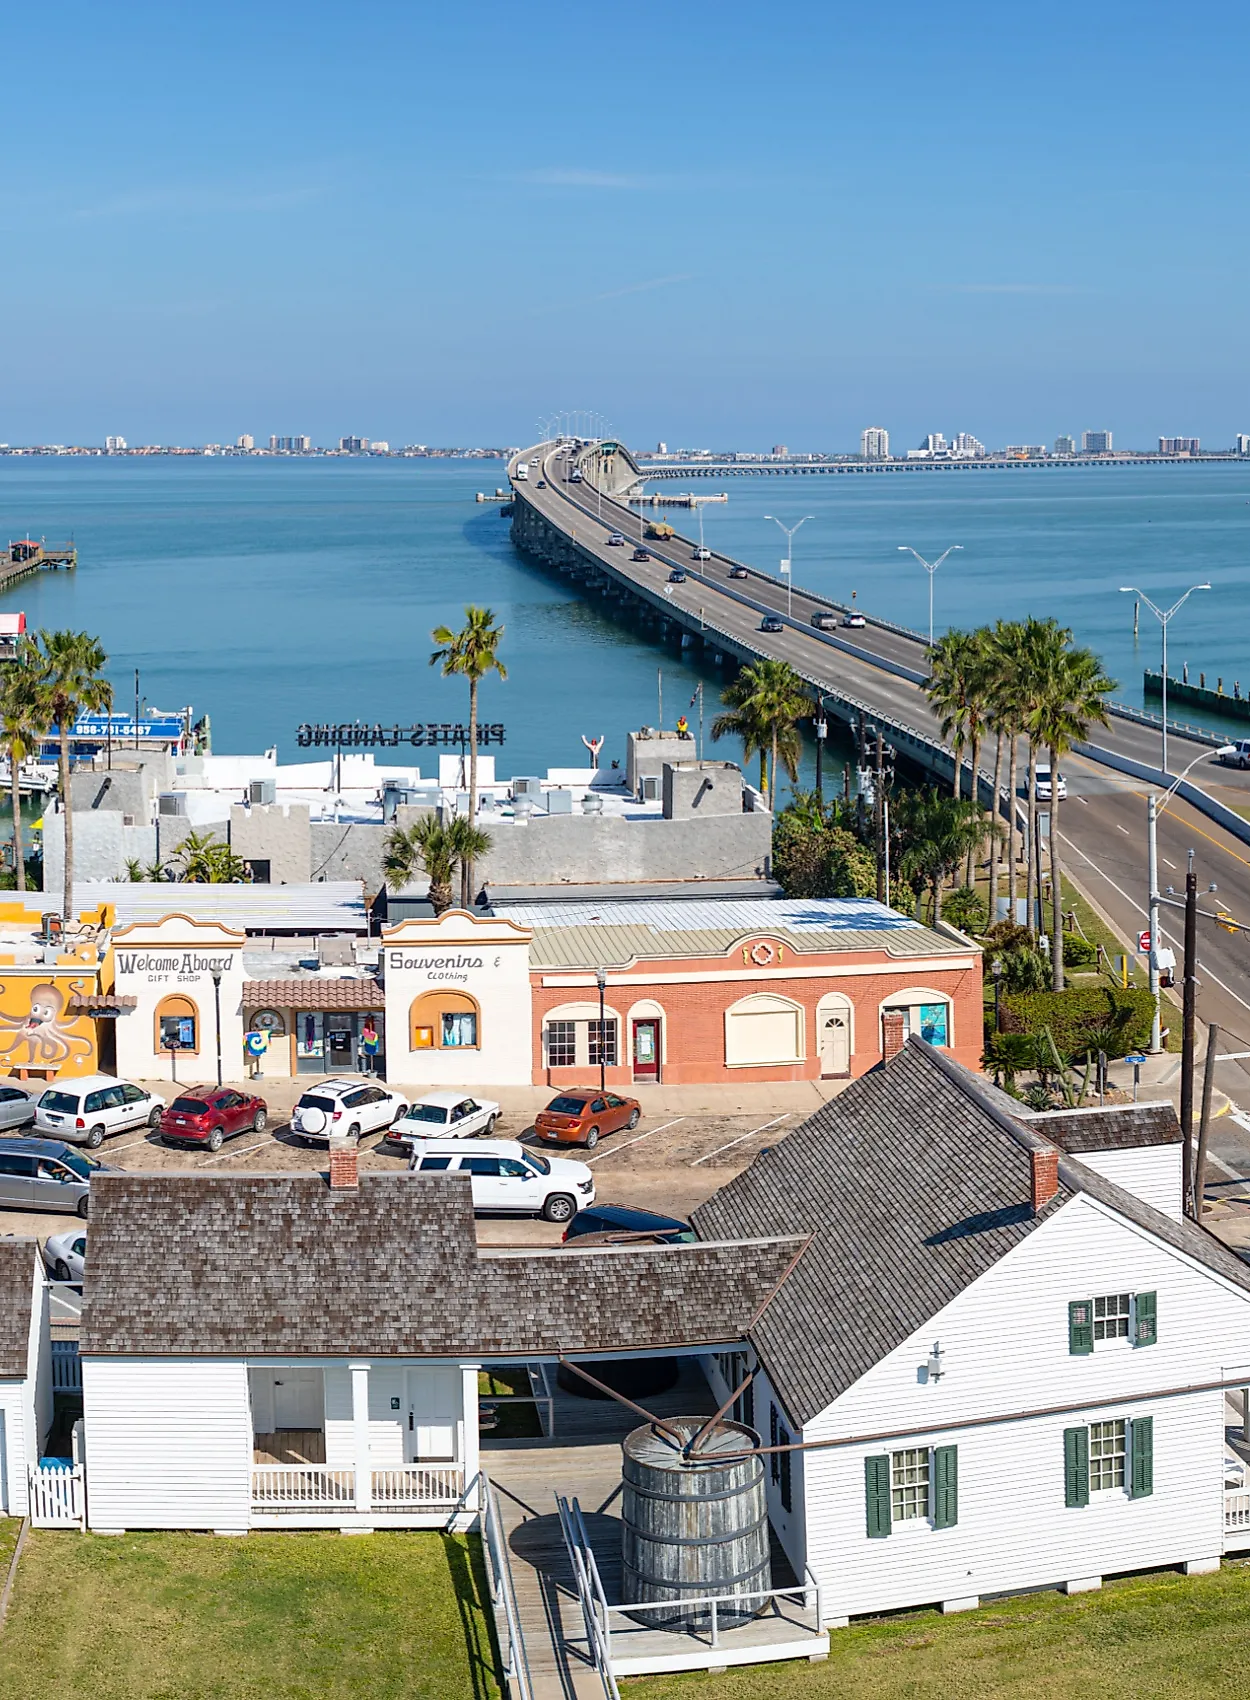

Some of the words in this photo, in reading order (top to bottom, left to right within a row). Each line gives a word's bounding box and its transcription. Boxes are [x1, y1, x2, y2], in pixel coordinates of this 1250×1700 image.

[117, 953, 180, 974] Welcome
[179, 953, 234, 974] Aboard
[390, 952, 484, 970] Souvenirs
[147, 974, 169, 982] GIFT
[176, 974, 201, 982] SHOP
